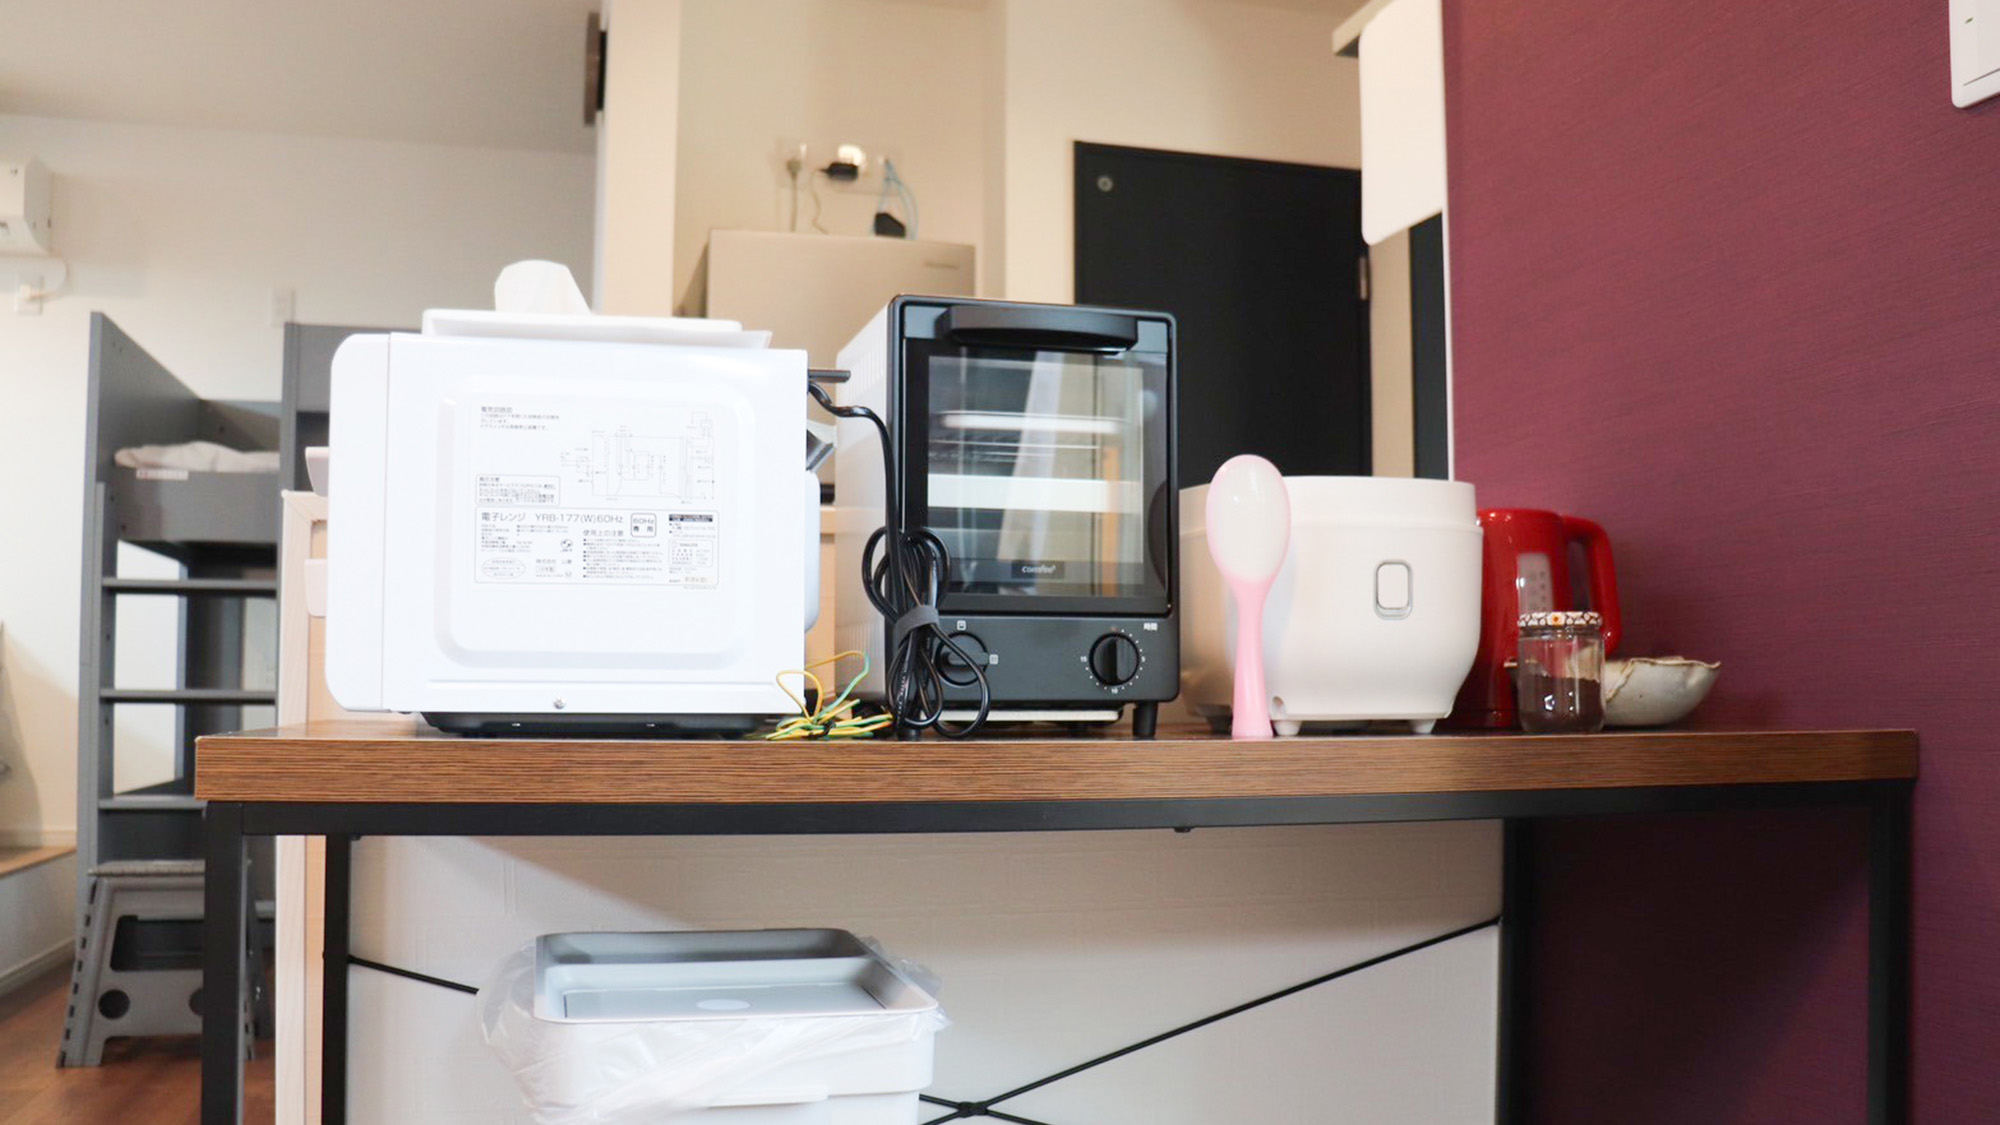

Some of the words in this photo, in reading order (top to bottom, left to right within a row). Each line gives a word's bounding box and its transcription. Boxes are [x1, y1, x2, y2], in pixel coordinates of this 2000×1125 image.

[481, 512, 526, 522] 電子レンジ
[535, 513, 623, 523] YRB-177(W)60Hz
[633, 517, 654, 525] 60Hz
